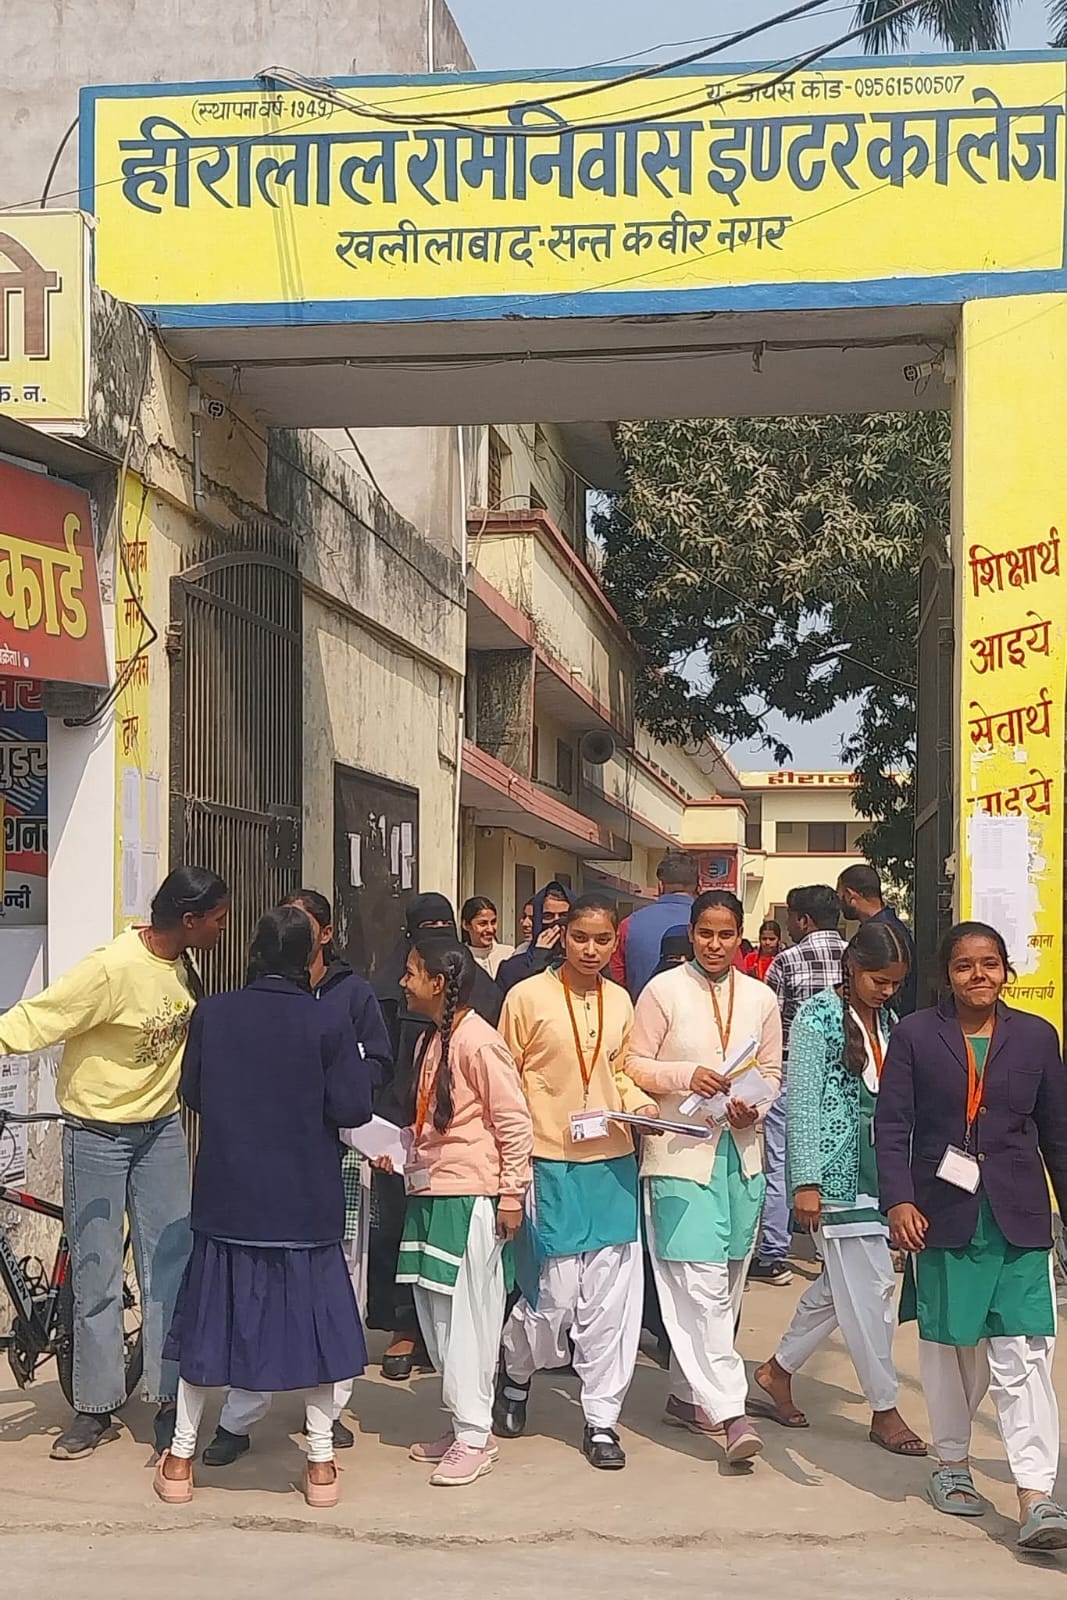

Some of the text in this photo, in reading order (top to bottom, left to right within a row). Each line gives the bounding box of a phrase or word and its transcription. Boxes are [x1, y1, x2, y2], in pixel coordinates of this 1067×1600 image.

[118, 87, 1065, 214] हीरालाल रामनिवास इण्टर कालेज
[622, 210, 711, 256] कबीर
[717, 216, 792, 254] नगर
[970, 611, 1052, 674] आइये
